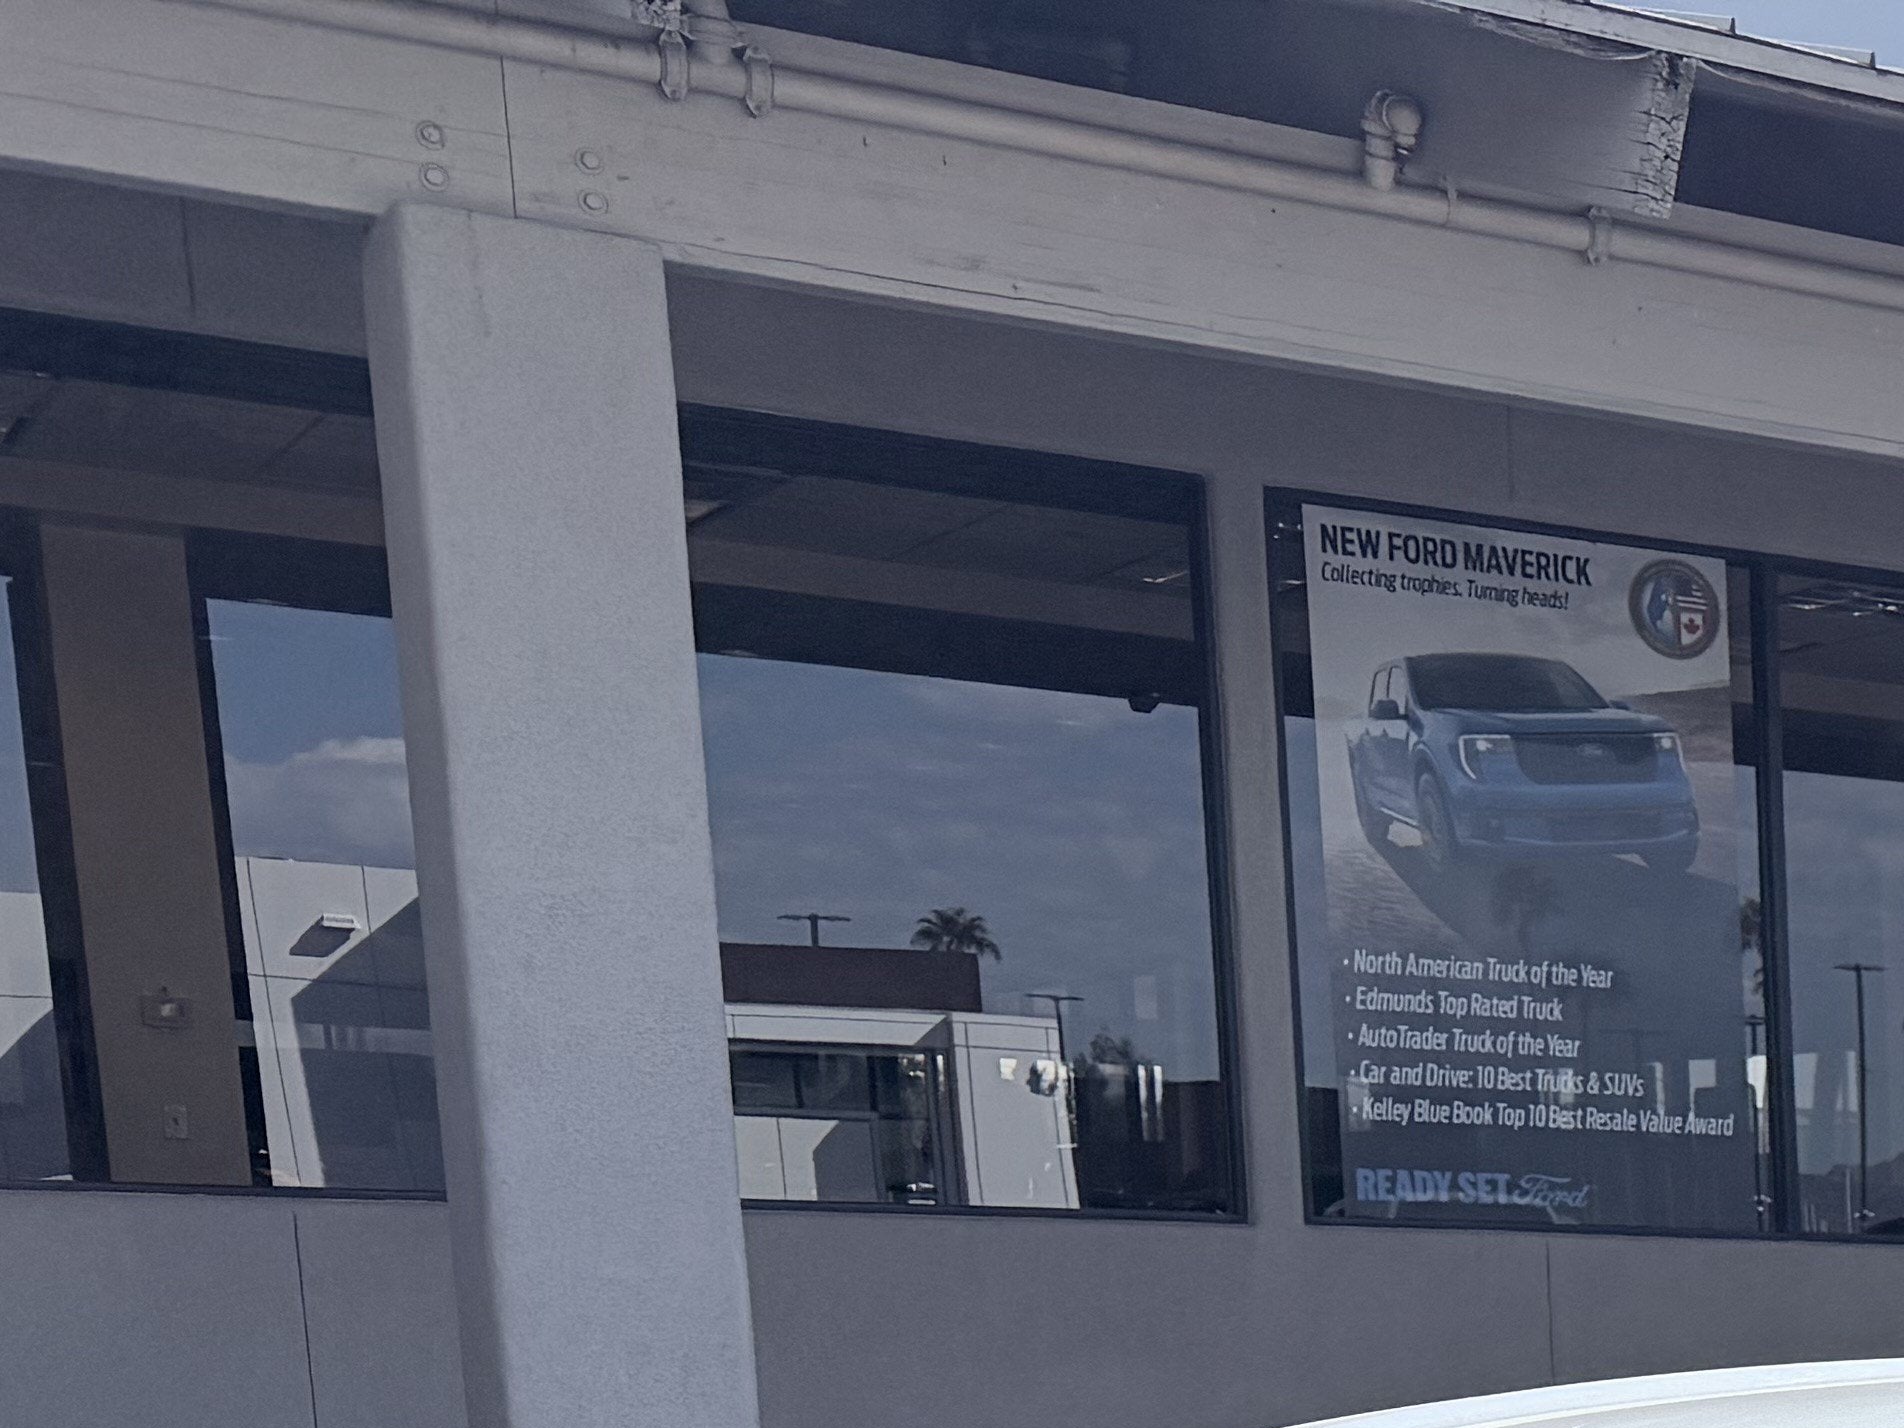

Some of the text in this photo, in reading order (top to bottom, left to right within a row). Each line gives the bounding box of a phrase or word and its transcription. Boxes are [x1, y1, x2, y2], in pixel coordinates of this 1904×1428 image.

[1320, 523, 1592, 587] NEW FORD MAVERICK
[1321, 561, 1397, 593] Collecting
[1467, 579, 1519, 608] Turning
[1522, 586, 1570, 610] heads!
[1353, 949, 1614, 989] North American Truck of the Year
[1355, 985, 1564, 1022] Edmunds Top Rated Truck
[1357, 1023, 1581, 1059] AutoTrader Truck of the Year
[1360, 1060, 1645, 1097] Car and Drive: 10 Best Trucks & SUVs
[1362, 1096, 1735, 1137] Kelley Blue Book Top 10 Best Resale Value Award
[1355, 1167, 1591, 1207] READY SET Ford
